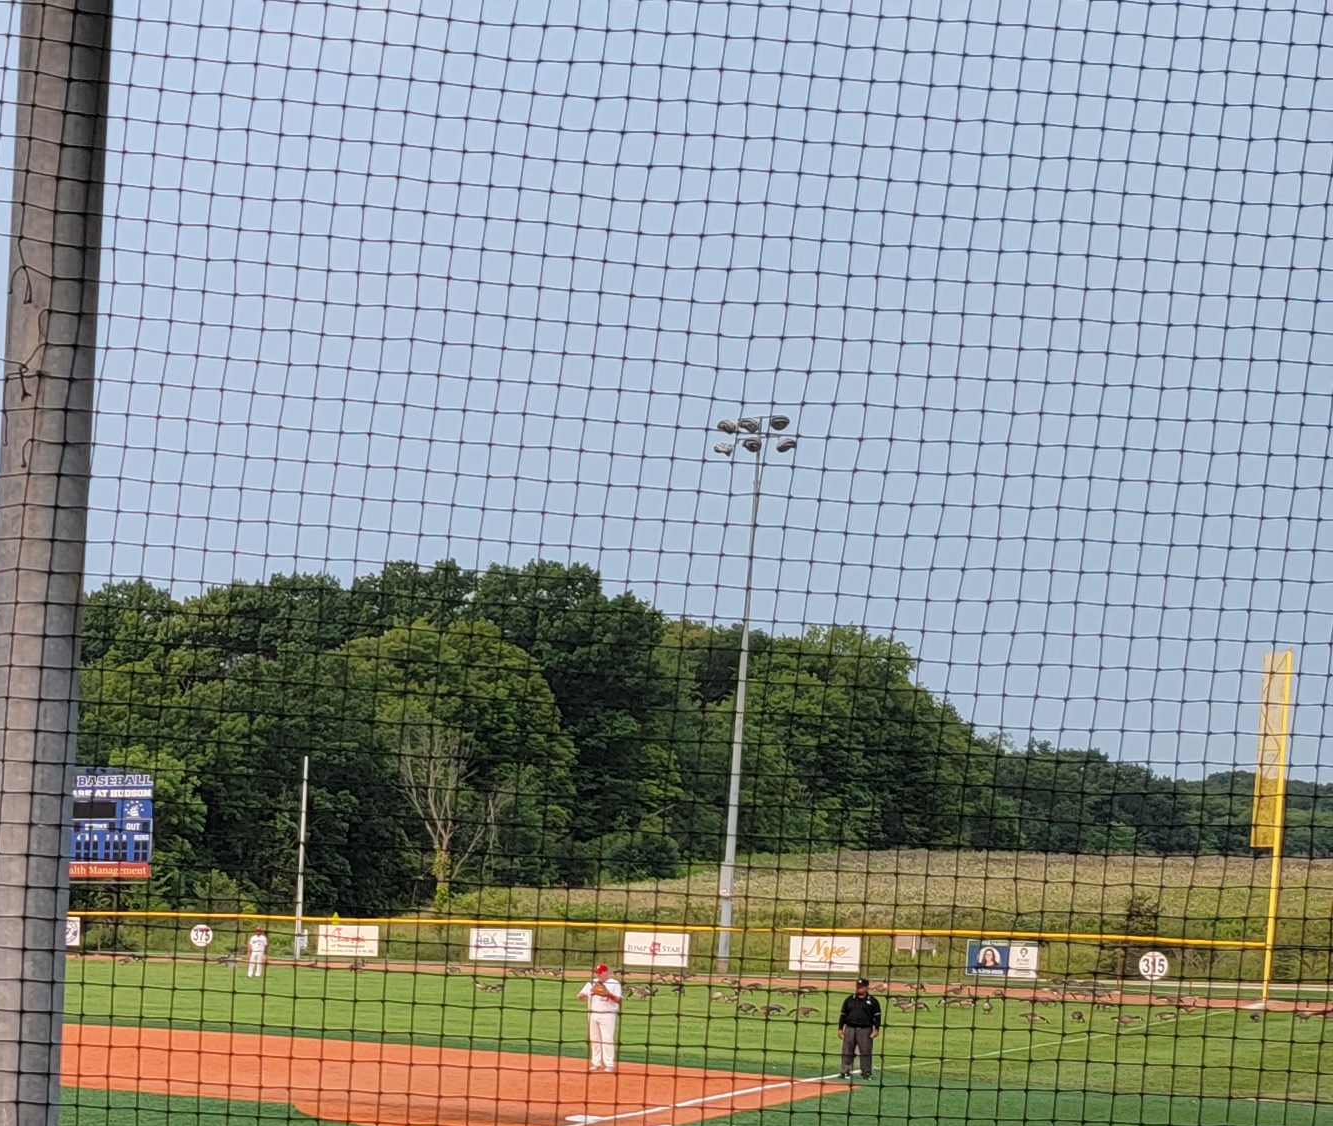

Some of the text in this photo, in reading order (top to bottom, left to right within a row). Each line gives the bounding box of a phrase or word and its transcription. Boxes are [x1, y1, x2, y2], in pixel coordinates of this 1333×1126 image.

[76, 774, 153, 787] BASEBALL
[94, 789, 108, 797] AT
[109, 789, 152, 798] HUDSON
[193, 927, 210, 942] 375
[1142, 957, 1165, 974] 315
